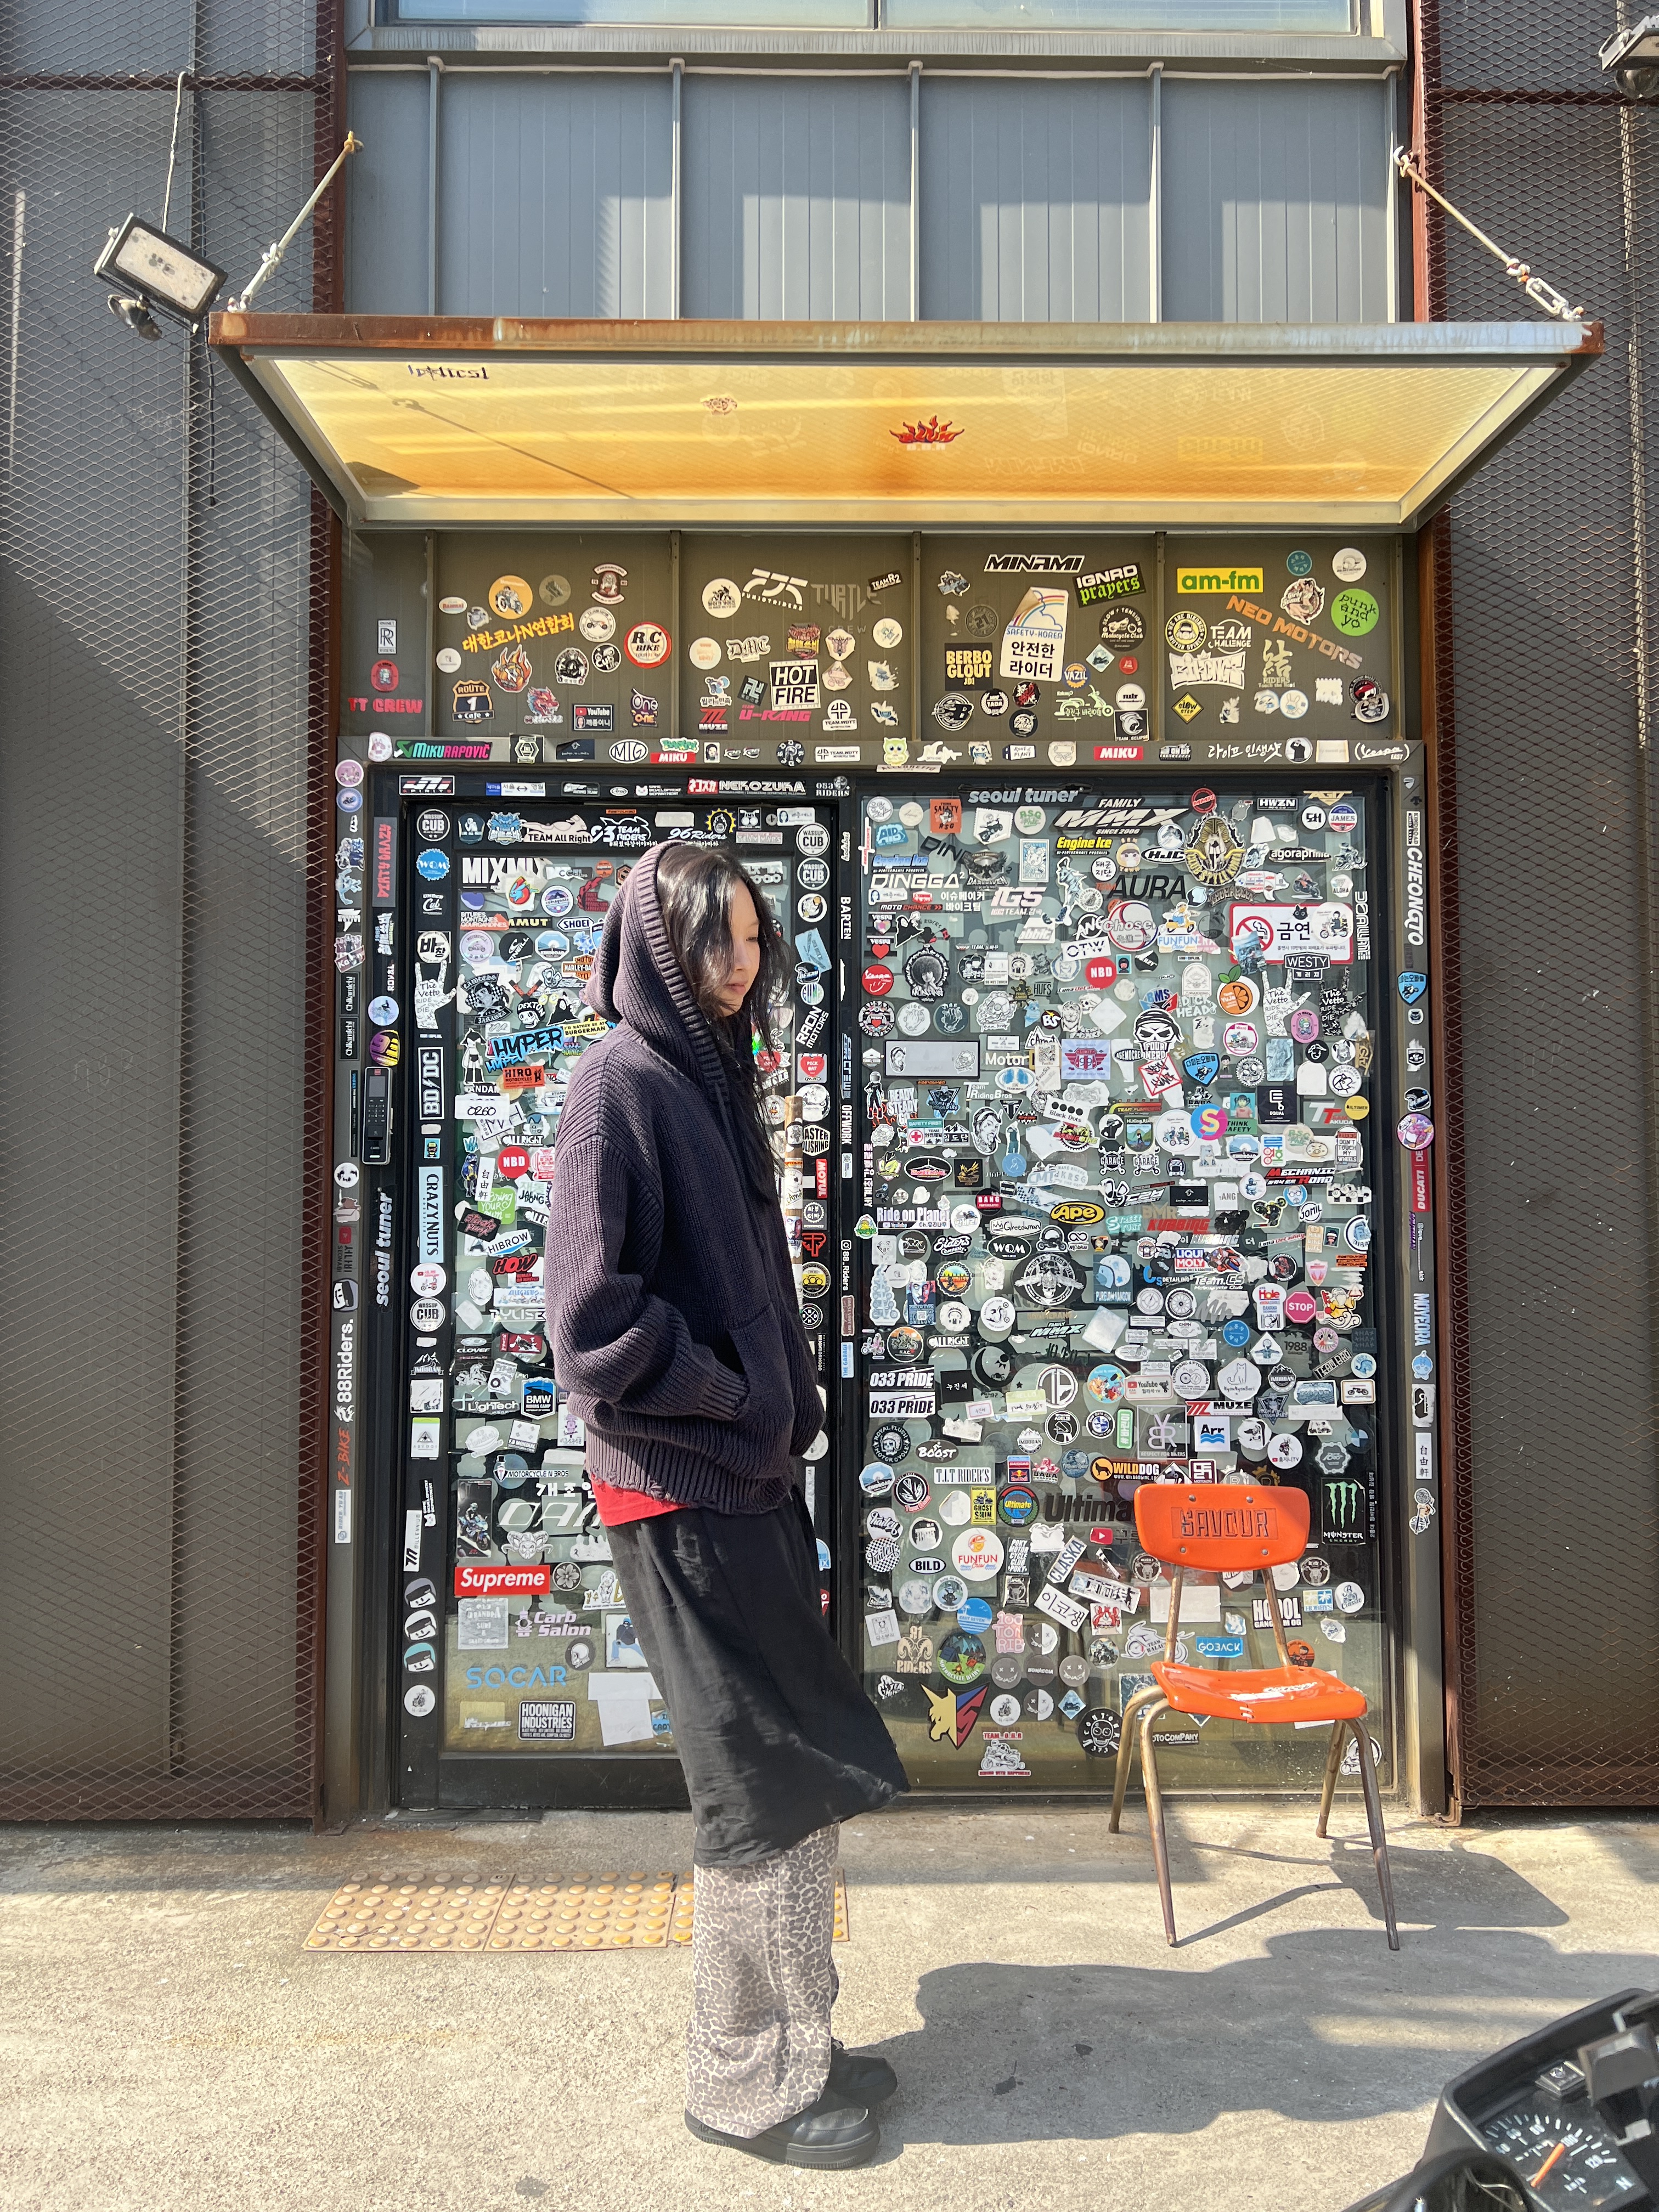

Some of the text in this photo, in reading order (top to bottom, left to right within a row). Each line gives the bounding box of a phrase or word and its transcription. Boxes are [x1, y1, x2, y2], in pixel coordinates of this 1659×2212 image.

[986, 556, 1082, 571] MINAMI
[1076, 565, 1138, 589] IGNRD
[1182, 571, 1259, 589] am-fm
[1079, 575, 1141, 605] prayers
[1339, 594, 1376, 614] punk
[1340, 604, 1368, 621] and
[1341, 616, 1361, 629] yo
[462, 612, 574, 653] 대한코나N연합회
[1006, 628, 1063, 640] SAFETY-KOREA
[1210, 626, 1251, 640] TEAM
[1226, 595, 1363, 669] NEO MOTORS
[1011, 641, 1055, 659] 안전한
[1208, 640, 1251, 648] CHALLENGE
[946, 650, 992, 665] BERBO
[775, 666, 815, 685] HOT
[946, 664, 992, 679] GLOUT
[1010, 660, 1053, 679] 라이더
[1064, 670, 1088, 681] VAZIL
[963, 677, 975, 686] JDI
[458, 684, 485, 693] ROUTE
[775, 686, 816, 705] FIRE
[348, 698, 423, 713] TT CREW
[467, 697, 477, 710] 1
[588, 708, 610, 716] YouTube
[740, 710, 812, 721] U-RANG
[1099, 748, 1138, 758] MIKU
[1208, 742, 1283, 762] 라이프 인생샷
[719, 781, 806, 792] NEKOZUKA
[968, 788, 1078, 803] seoul tuner
[1098, 798, 1143, 808] FAMILY
[1260, 799, 1295, 807] HWZN
[1054, 808, 1189, 827] MMX
[1330, 814, 1356, 822] JAMES
[422, 821, 445, 831] CUB
[529, 833, 591, 844] TEAM All Right
[803, 837, 823, 847] CUB
[1057, 837, 1113, 850] Engine Ice
[1148, 849, 1185, 860] HJC
[1107, 876, 1187, 899] AURA
[564, 920, 589, 928] SHOEI
[1277, 922, 1311, 941] 금연
[1286, 956, 1328, 968] WESTY
[1090, 966, 1113, 978] NBD
[1034, 983, 1052, 995] HUFS
[517, 1001, 546, 1017] DEXTON
[565, 1026, 606, 1036] BURGERMAN
[795, 1006, 822, 1045] RAON
[806, 1011, 829, 1048] MOTORS
[493, 1028, 563, 1059] HYPER
[1146, 1041, 1167, 1051] FOUR
[1146, 1051, 1166, 1059] NERD
[504, 1068, 532, 1077] HIRO
[889, 1087, 915, 1102] READY
[887, 1099, 918, 1113] STEADY
[1049, 1109, 1082, 1122] Black Dots
[841, 1104, 852, 1145] OFFWORK
[943, 1133, 969, 1143] 임도단
[503, 1156, 525, 1167] NBD
[1100, 1156, 1124, 1166] GARAGE
[1268, 1167, 1335, 1177] MECHANIC
[817, 1161, 827, 1197] MOTUL
[1298, 1175, 1334, 1184] ROAD
[1417, 1170, 1426, 1210] DUCATI
[426, 1173, 439, 1256] CRAZY NUTS
[877, 1207, 900, 1221] Ride
[901, 1210, 916, 1221] on
[1054, 1205, 1096, 1219] Ape
[374, 1192, 393, 1307] seoul tuner
[488, 1232, 529, 1254] HIBROW
[1176, 1249, 1204, 1257] LIQUI
[1176, 1259, 1204, 1268] MOLY
[1288, 1302, 1313, 1312] STOP
[1413, 1293, 1431, 1346] MOYEORA
[1284, 1341, 1307, 1351] 1988
[870, 1372, 934, 1387] 033 PRIDE
[526, 1395, 551, 1404] BMW
[1213, 1401, 1252, 1409] MUZE
[871, 1400, 934, 1414] 033 PRIDE
[917, 1446, 957, 1459] BOOST
[1113, 1462, 1160, 1476] WILDDOG
[1045, 1492, 1135, 1522] Ultima
[1180, 1509, 1269, 1537] SAVOUR
[915, 1560, 940, 1571] BILD
[958, 1554, 997, 1564] FUNFUN
[1049, 1538, 1085, 1583] CLASKA
[460, 1568, 545, 1592] Supreme
[534, 1611, 577, 1624] Carb
[538, 1624, 591, 1637] Salon
[466, 1666, 567, 1690] SOCAR
[522, 1703, 573, 1717] HOONIGAN
[521, 1716, 573, 1729] INDUSTRIES
